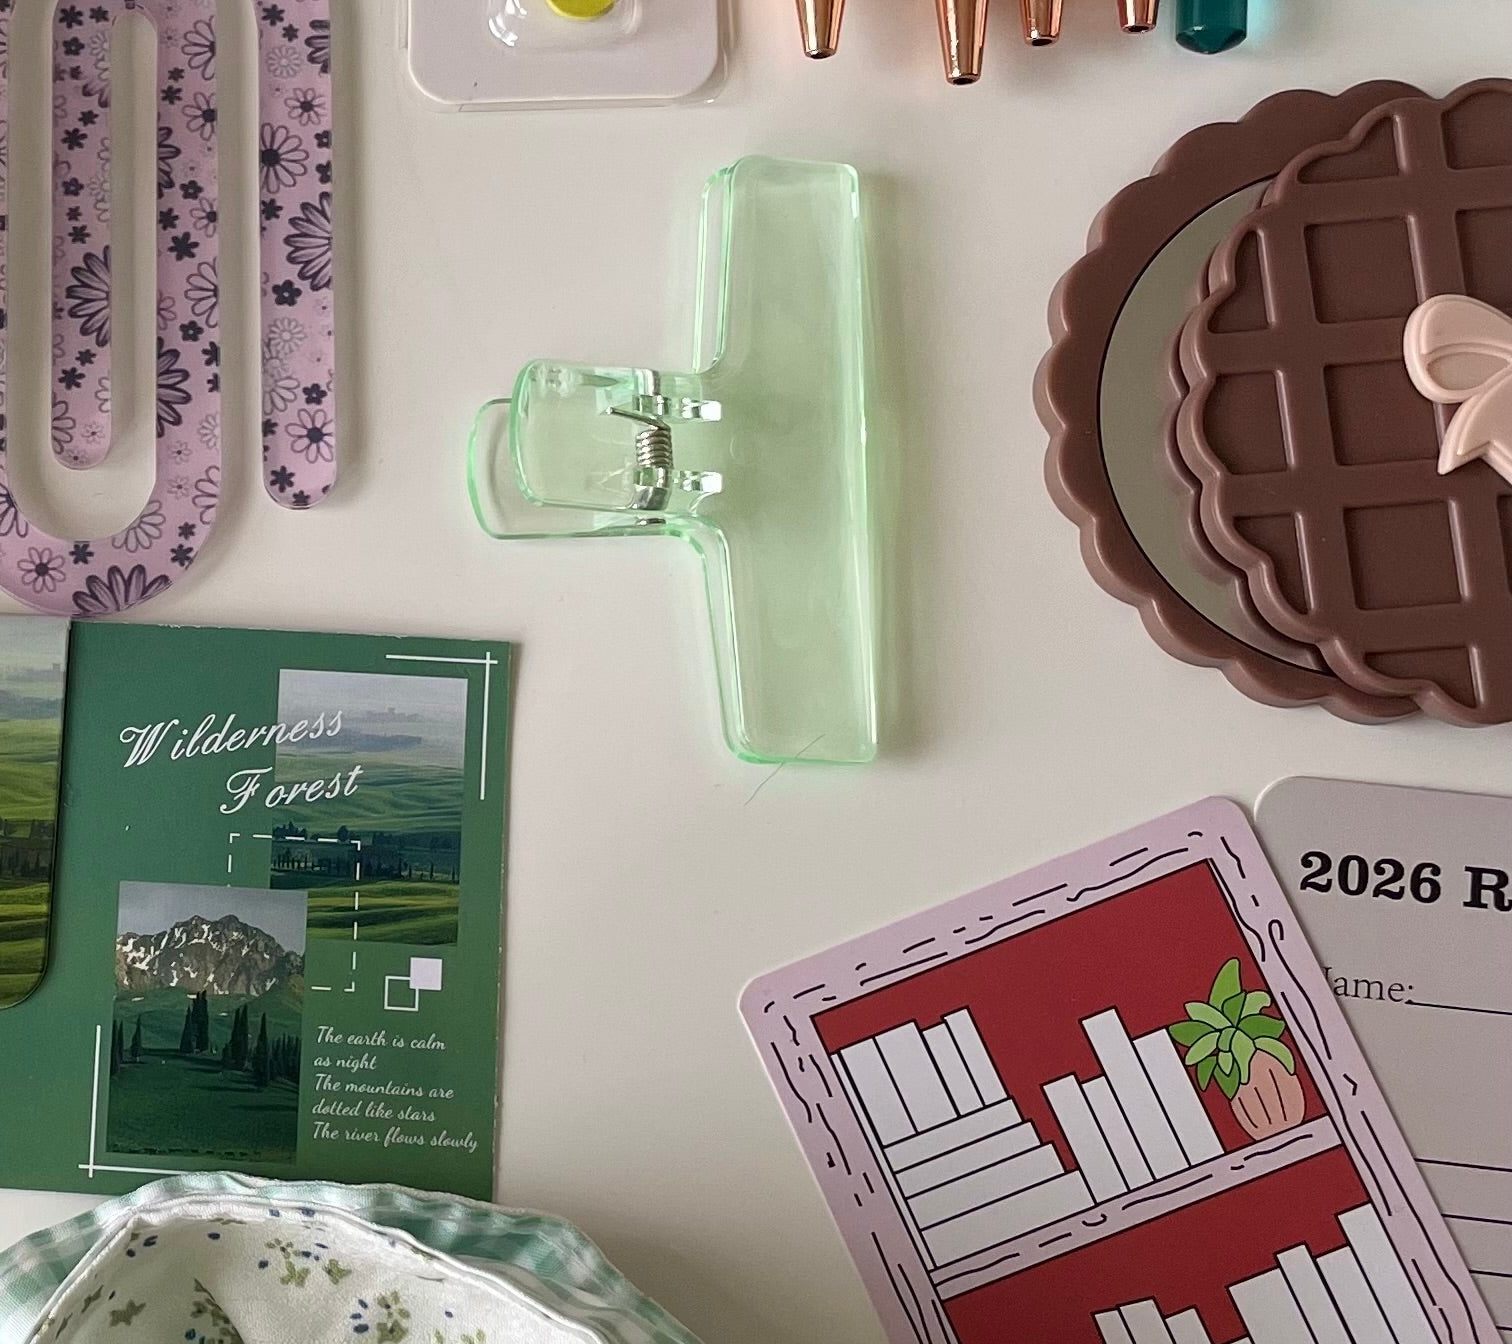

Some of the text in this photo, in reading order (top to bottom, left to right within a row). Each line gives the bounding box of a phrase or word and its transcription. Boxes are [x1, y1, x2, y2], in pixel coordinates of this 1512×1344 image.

[119, 709, 344, 768] Wilderness
[218, 764, 365, 815] Forest
[1298, 849, 1442, 905] 2026
[316, 1025, 447, 1051] The earth is calm
[313, 1053, 377, 1073] as night
[315, 1072, 455, 1100] The mountains are
[311, 1097, 436, 1122] dotted like stars
[312, 1120, 479, 1154] The river flows slowly
